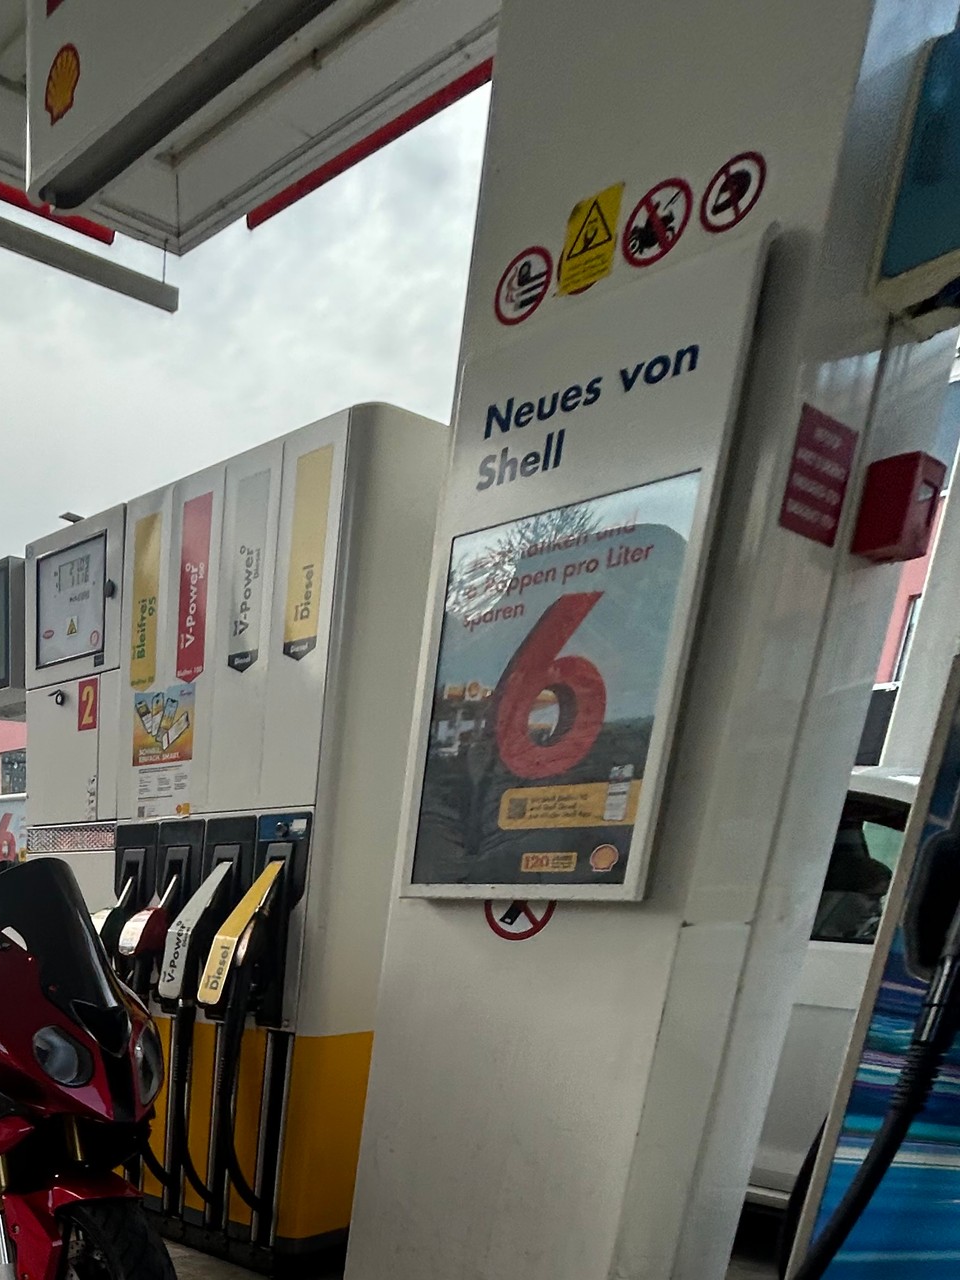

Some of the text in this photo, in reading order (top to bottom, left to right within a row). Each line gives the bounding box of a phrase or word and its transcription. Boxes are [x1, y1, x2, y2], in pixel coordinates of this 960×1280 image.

[483, 344, 700, 440] Neues von
[476, 429, 566, 491] Shell
[239, 548, 254, 636] V-Power
[300, 563, 315, 620] Diesel
[562, 556, 599, 586] pro
[606, 542, 655, 569] Liter
[136, 598, 148, 659] Bleifrei
[148, 596, 157, 616] 95
[185, 564, 199, 648] V-Power
[462, 602, 525, 633] sparen
[81, 685, 95, 726] 2
[495, 591, 607, 780] 6
[166, 922, 187, 983] V-Power
[209, 945, 231, 991] Diesel
